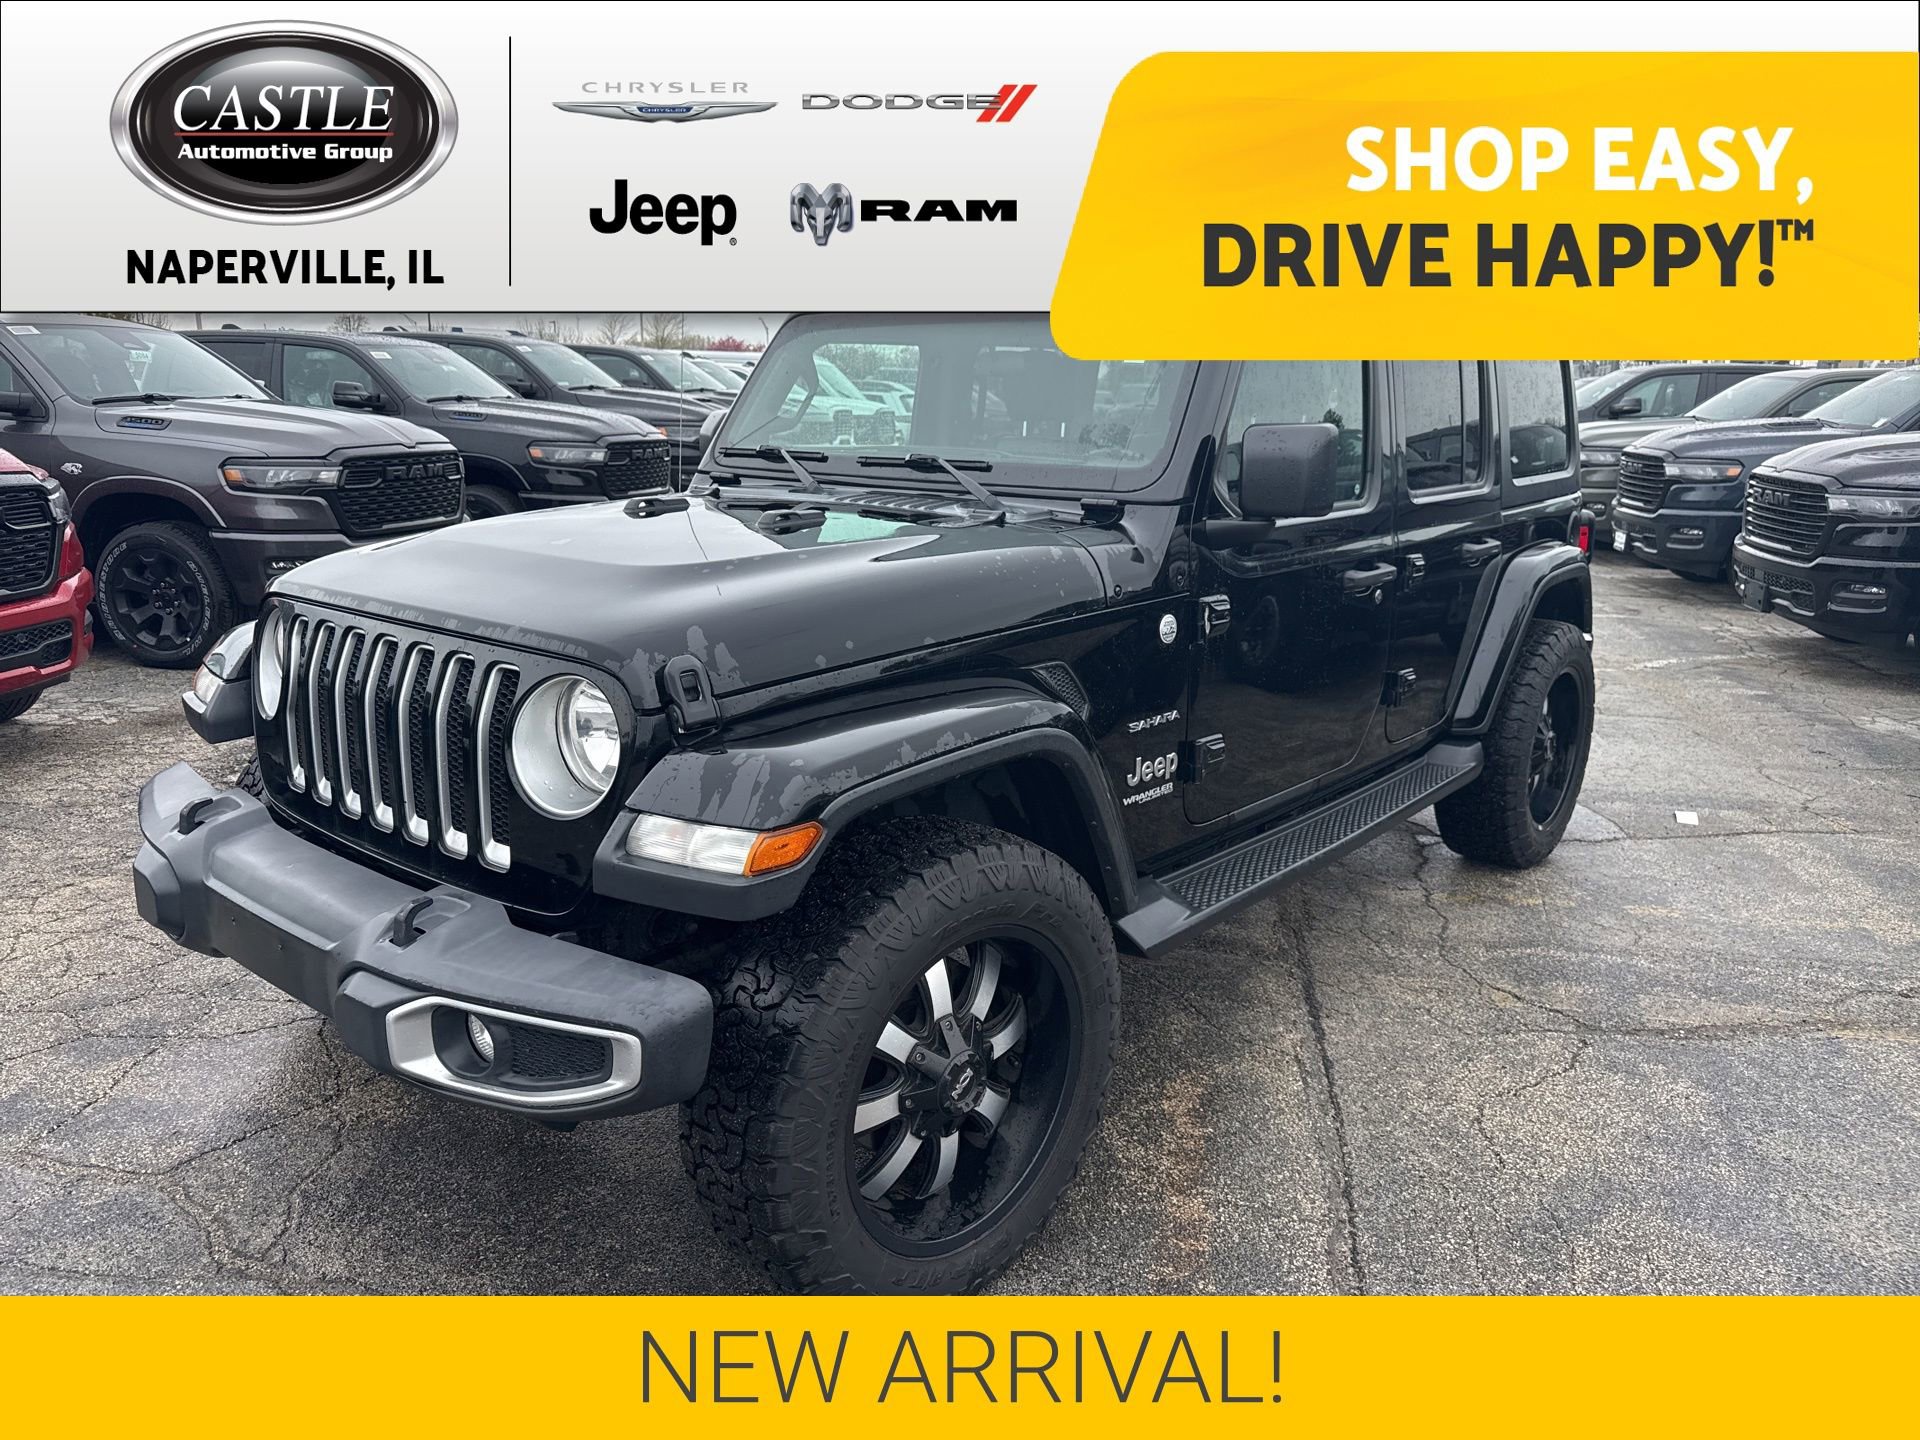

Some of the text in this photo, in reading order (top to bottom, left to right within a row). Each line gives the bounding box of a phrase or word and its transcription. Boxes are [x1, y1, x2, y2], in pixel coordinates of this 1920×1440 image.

[384, 462, 443, 480] RAM
[1751, 486, 1791, 507] RAM
[1127, 709, 1181, 734] SAHARA
[1126, 751, 1179, 787] Jeep
[1122, 781, 1174, 807] WRANGLER
